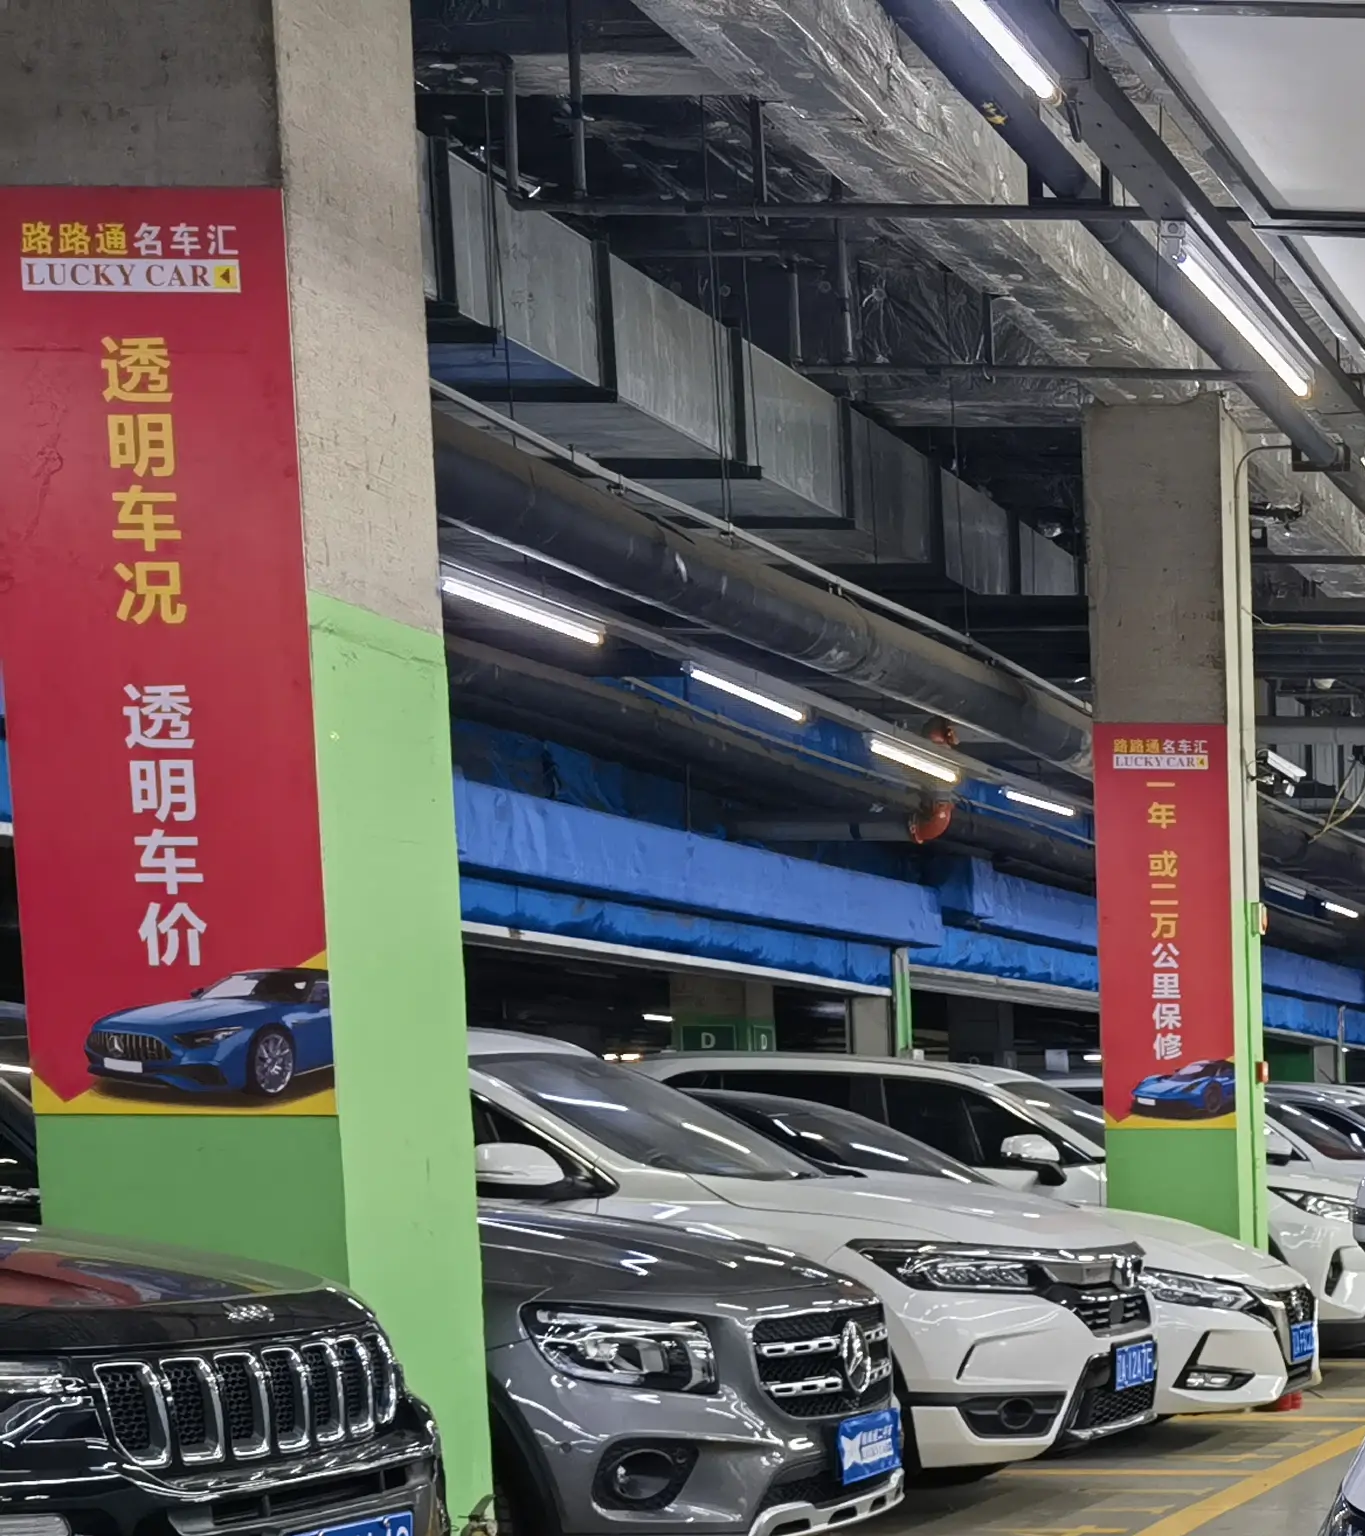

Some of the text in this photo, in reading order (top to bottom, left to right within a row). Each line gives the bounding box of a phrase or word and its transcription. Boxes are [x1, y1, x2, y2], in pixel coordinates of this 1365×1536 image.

[21, 222, 238, 256] 路路通名车汇
[26, 263, 212, 287] LUCKY CAR
[101, 336, 187, 625] 透明车况
[1115, 756, 1196, 768] LUCKY CAR
[122, 684, 206, 966] 透明车价
[701, 1032, 716, 1049] D
[761, 1034, 768, 1050] D
